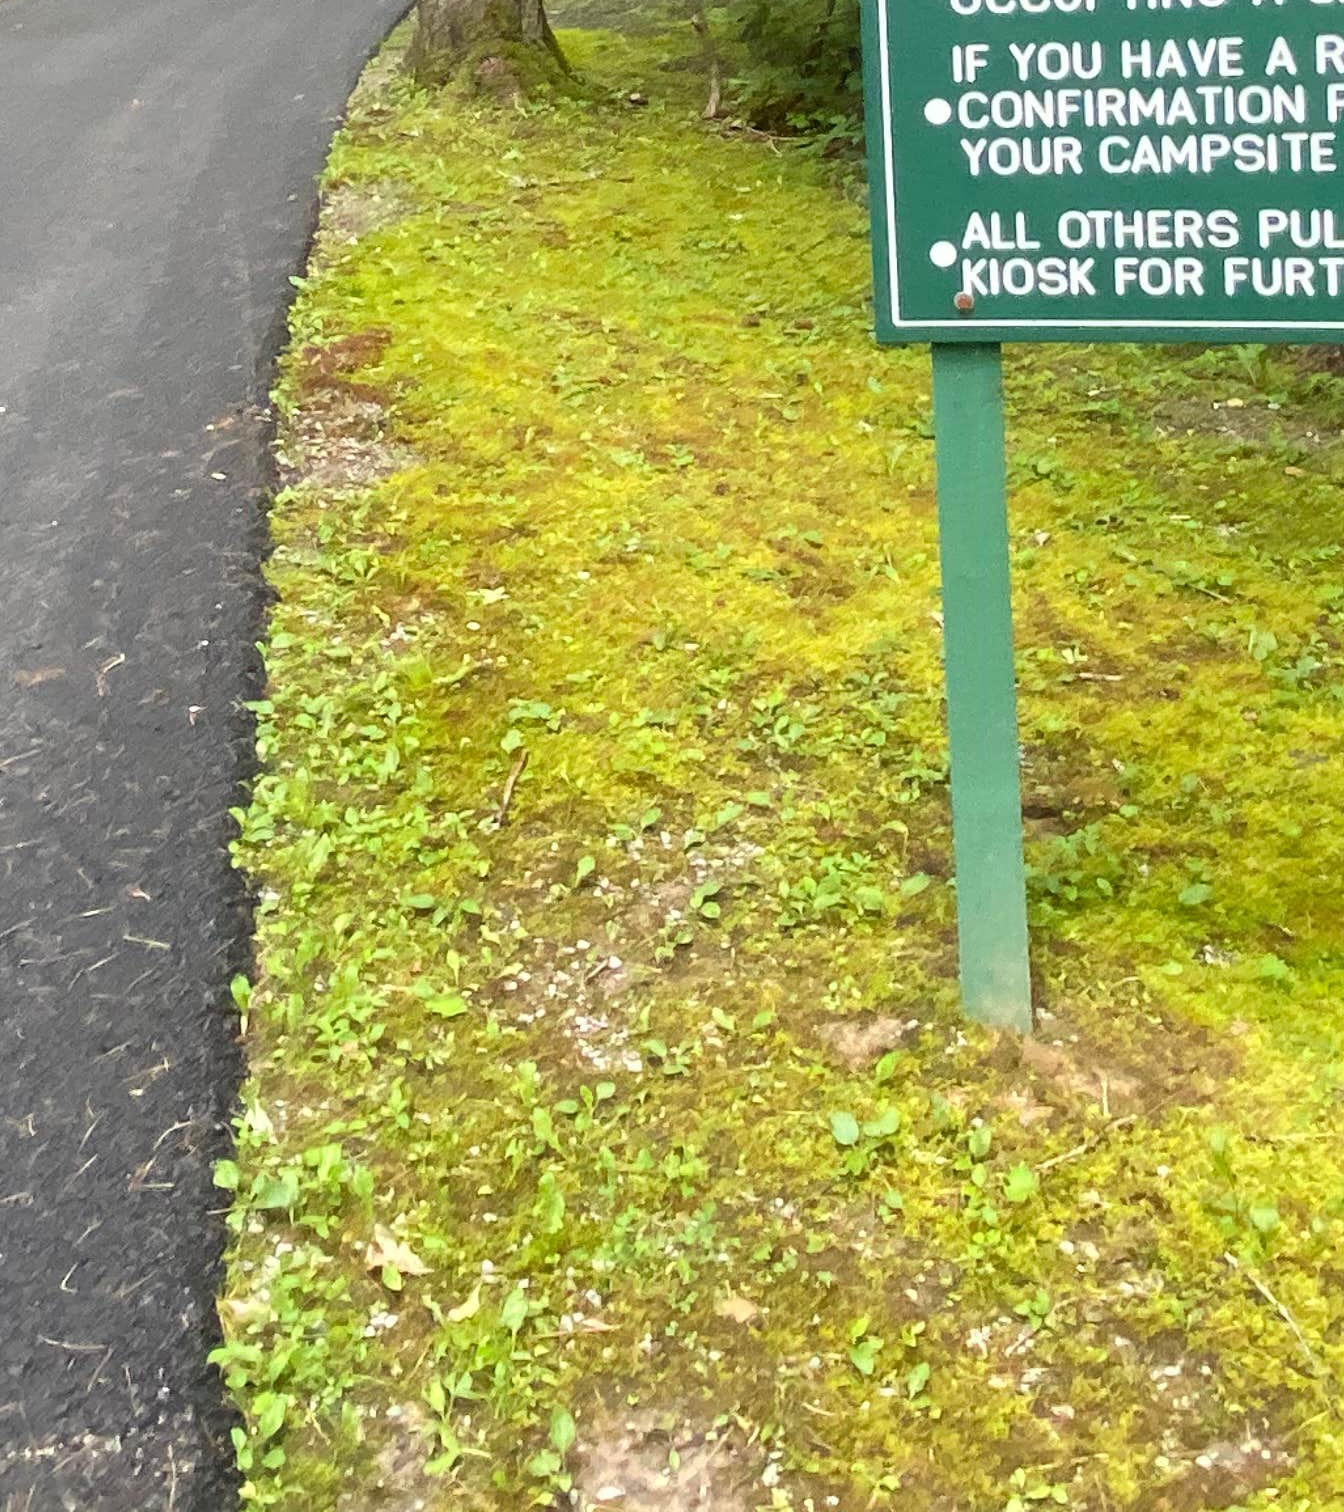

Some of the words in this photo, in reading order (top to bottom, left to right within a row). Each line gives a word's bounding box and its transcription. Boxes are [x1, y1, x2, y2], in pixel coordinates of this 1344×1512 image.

[952, 43, 990, 83] IF
[1008, 40, 1103, 82] YOU
[1121, 36, 1244, 79] HAVE
[1265, 36, 1298, 76] A
[957, 84, 1307, 130] CONFIRMATION
[960, 136, 1083, 176] YOUR
[1098, 131, 1337, 174] CAMPSITE
[961, 211, 1042, 251] ALL
[1058, 209, 1240, 250] OTHERS
[960, 256, 1097, 297] KIOSK
[1114, 257, 1205, 297] FOR
